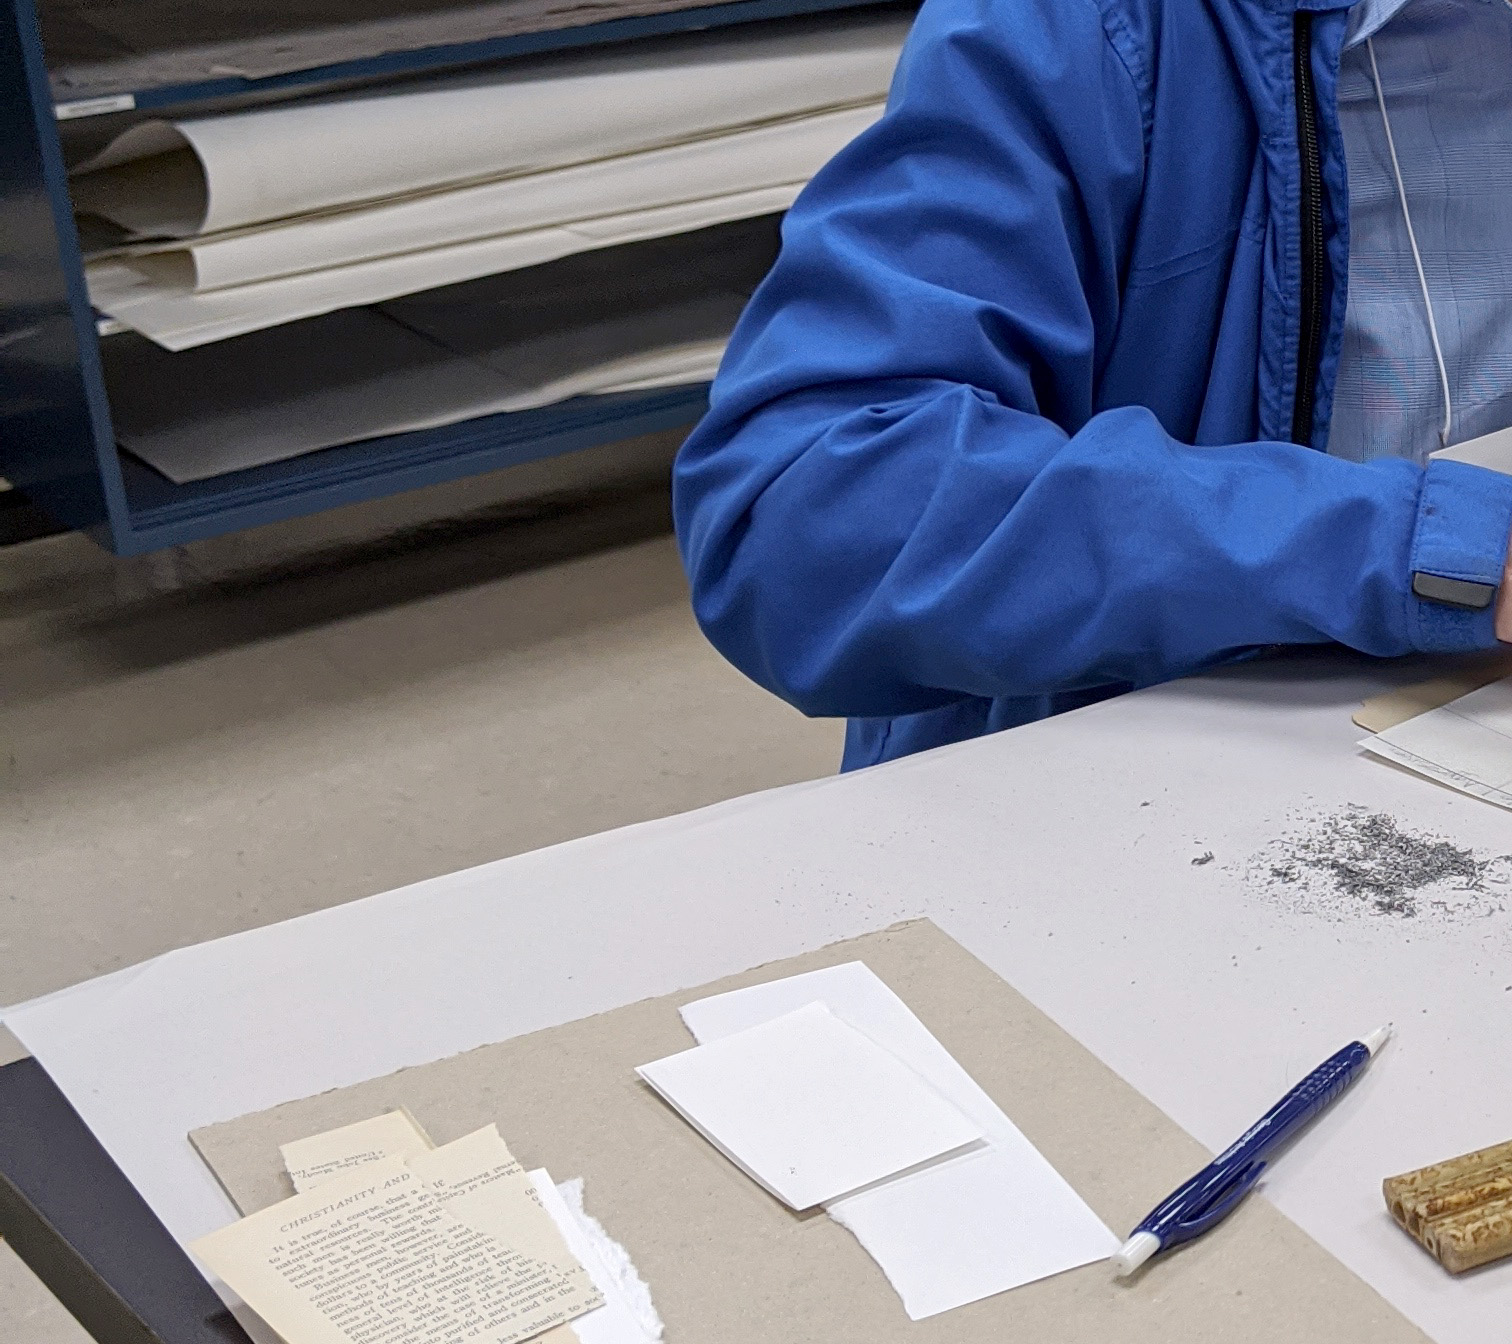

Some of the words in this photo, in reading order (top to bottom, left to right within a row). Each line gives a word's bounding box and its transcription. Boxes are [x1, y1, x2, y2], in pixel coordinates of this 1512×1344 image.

[280, 1187, 374, 1231] CHRISTIANITY
[383, 1173, 409, 1189] AND
[385, 1193, 407, 1204] that
[275, 1250, 314, 1270] natural
[379, 1214, 403, 1224] The
[282, 1263, 306, 1276] such
[311, 1251, 335, 1263] men
[356, 1229, 384, 1245] really
[391, 1214, 422, 1229] worth
[288, 1265, 323, 1282] society
[328, 1254, 348, 1265] has
[350, 1243, 376, 1256] been
[380, 1225, 417, 1242] willing
[420, 1214, 442, 1226] that
[289, 1222, 359, 1254] extraordinary
[366, 1201, 410, 1221] business
[294, 1274, 324, 1289] tunes
[342, 1246, 387, 1269] personal
[309, 1272, 371, 1301] conspicuous
[376, 1256, 408, 1273] public
[412, 1238, 448, 1256] service
[452, 1227, 472, 1239] and
[313, 1268, 360, 1290] Business
[446, 1223, 463, 1233] are
[329, 1299, 373, 1321] methods
[392, 1271, 436, 1292] teaching
[438, 1260, 458, 1273] and
[461, 1251, 483, 1262] who
[401, 1335, 420, 1344] the
[425, 1318, 459, 1335] means
[482, 1277, 550, 1309] transforming
[413, 1305, 445, 1321] which
[450, 1293, 471, 1304] will
[476, 1276, 510, 1294] relieve
[514, 1267, 532, 1277] the
[444, 1314, 484, 1337] purified
[487, 1304, 508, 1317] and
[510, 1277, 569, 1306] consecrated
[484, 1312, 516, 1329] others
[520, 1300, 540, 1313] and
[557, 1286, 575, 1296] the
[383, 1322, 427, 1344] consider
[431, 1312, 449, 1322] the
[453, 1301, 476, 1313] case
[496, 1332, 518, 1344] less
[521, 1312, 564, 1332] valuable
